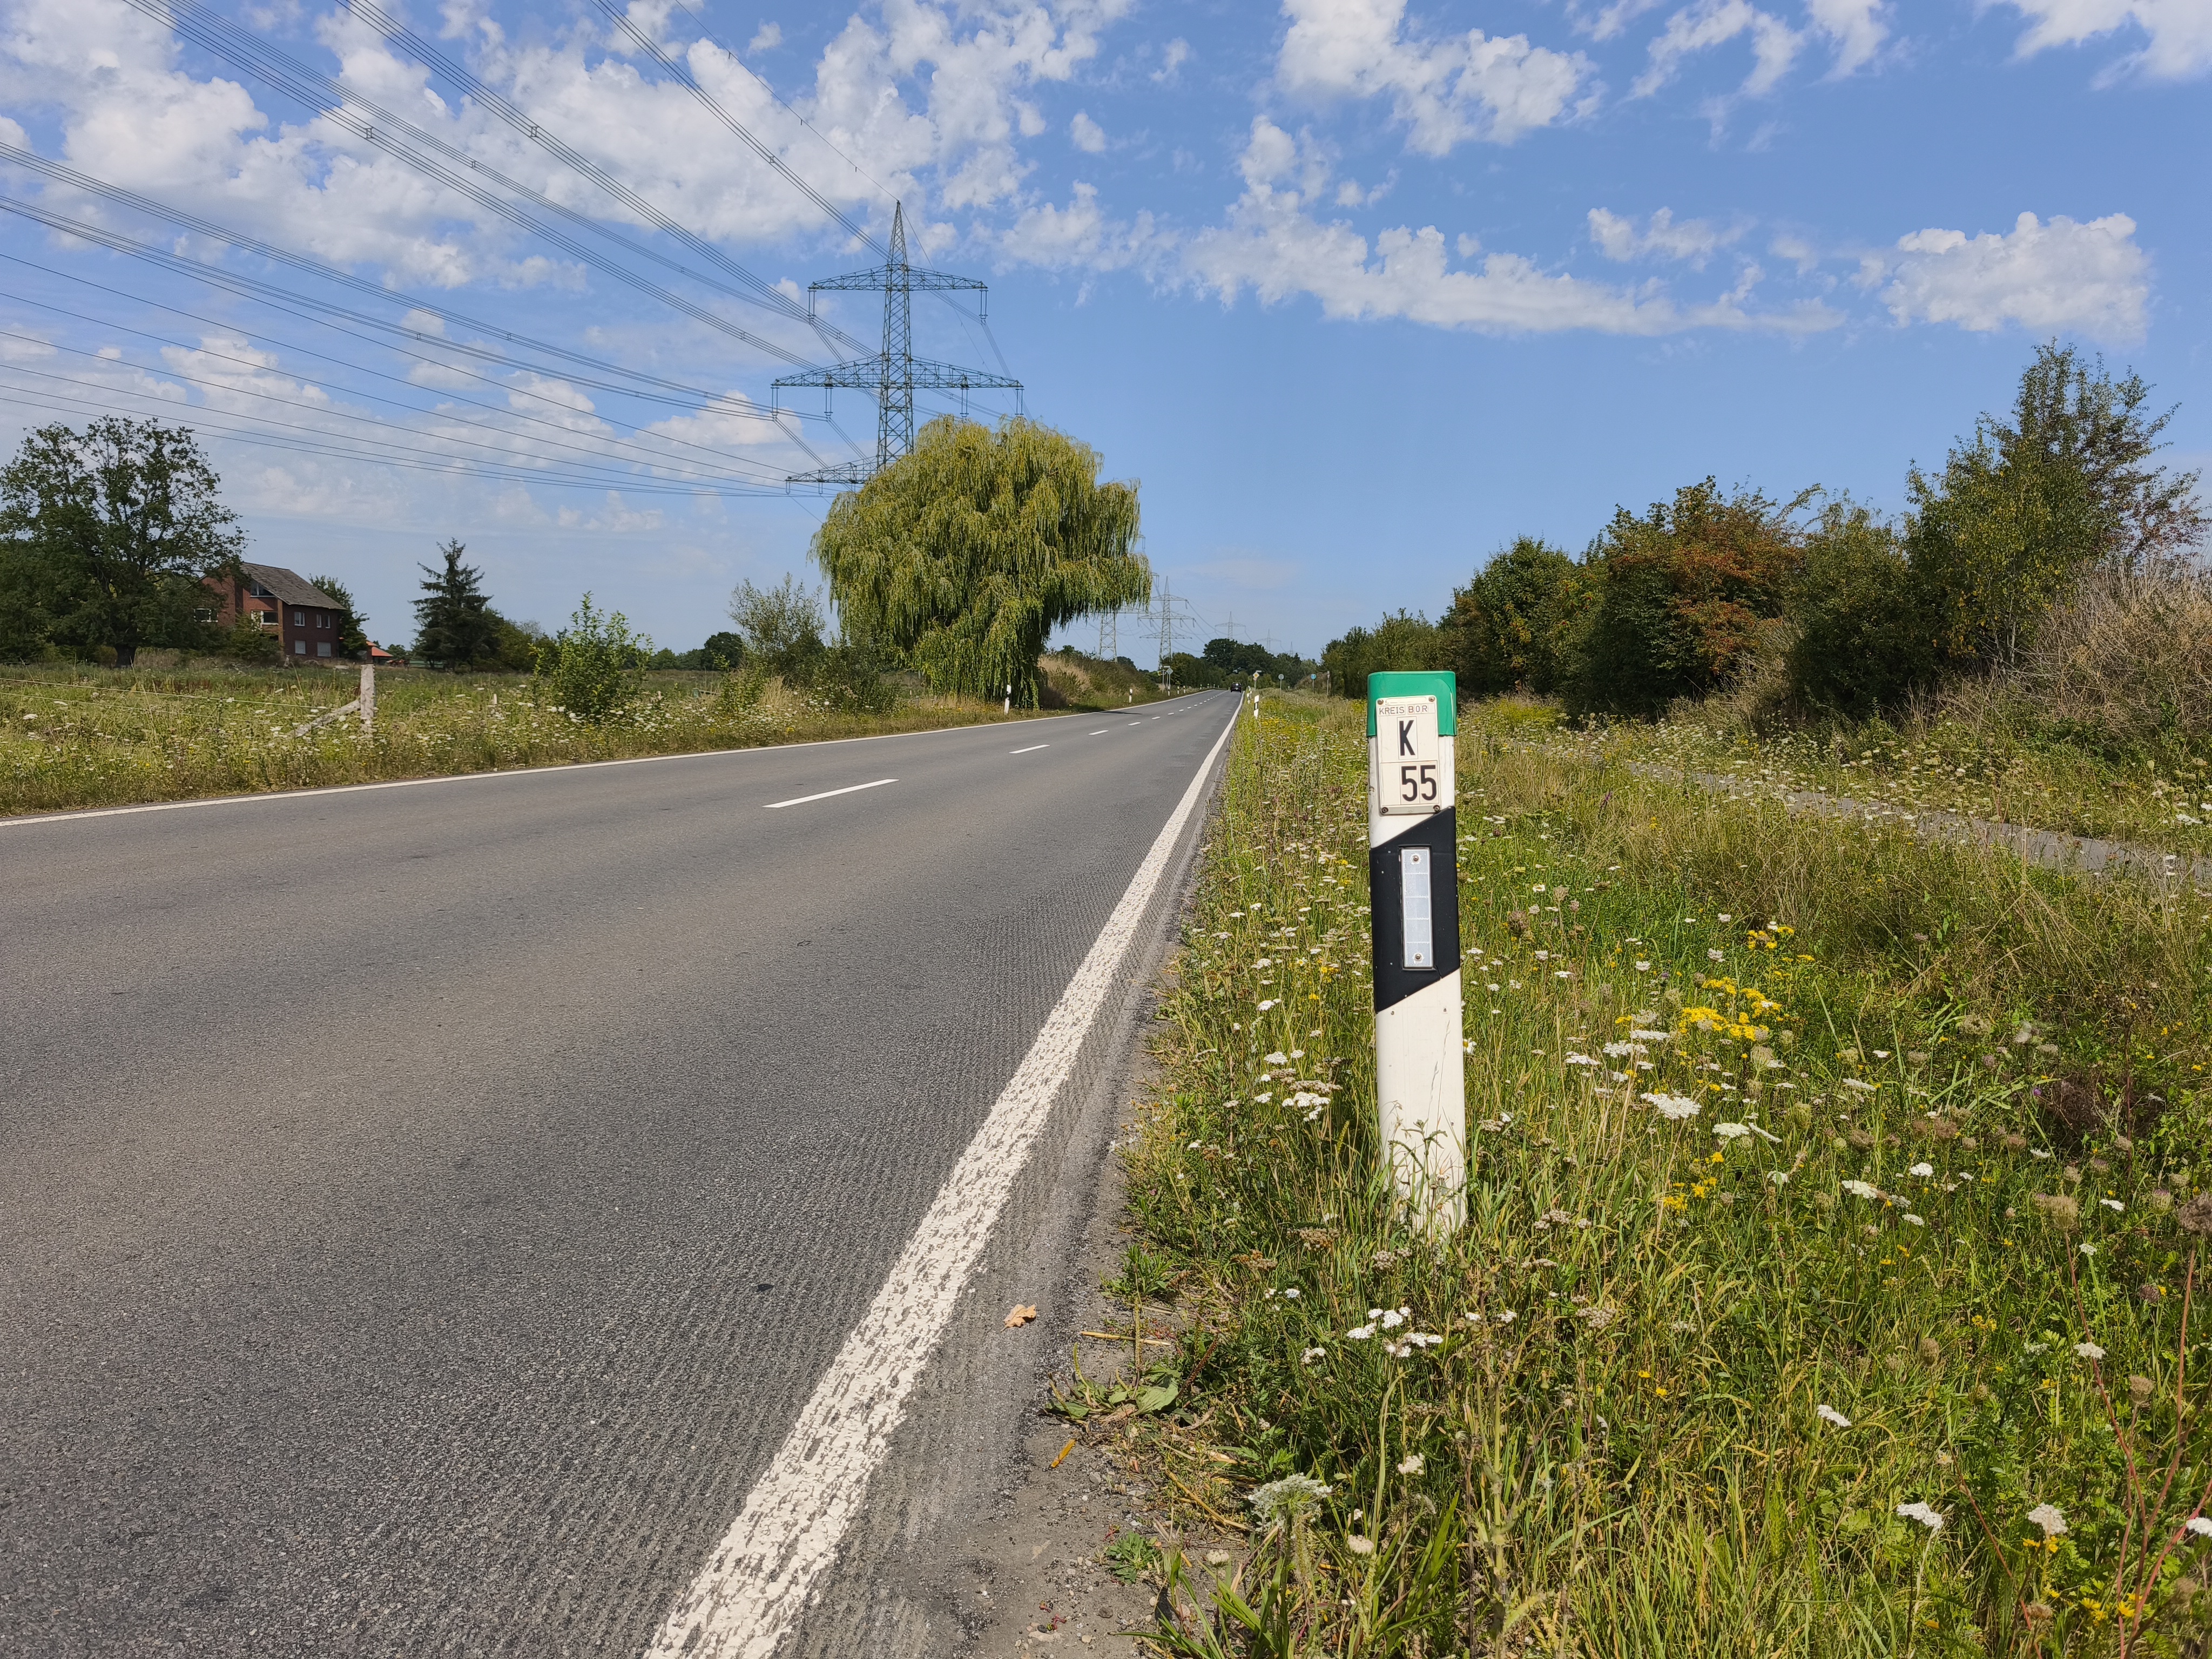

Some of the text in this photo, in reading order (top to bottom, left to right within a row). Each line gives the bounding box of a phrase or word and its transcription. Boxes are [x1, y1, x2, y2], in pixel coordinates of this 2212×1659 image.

[1379, 706, 1405, 715] KREIS
[1399, 719, 1415, 756] K
[1401, 765, 1437, 801] 55
